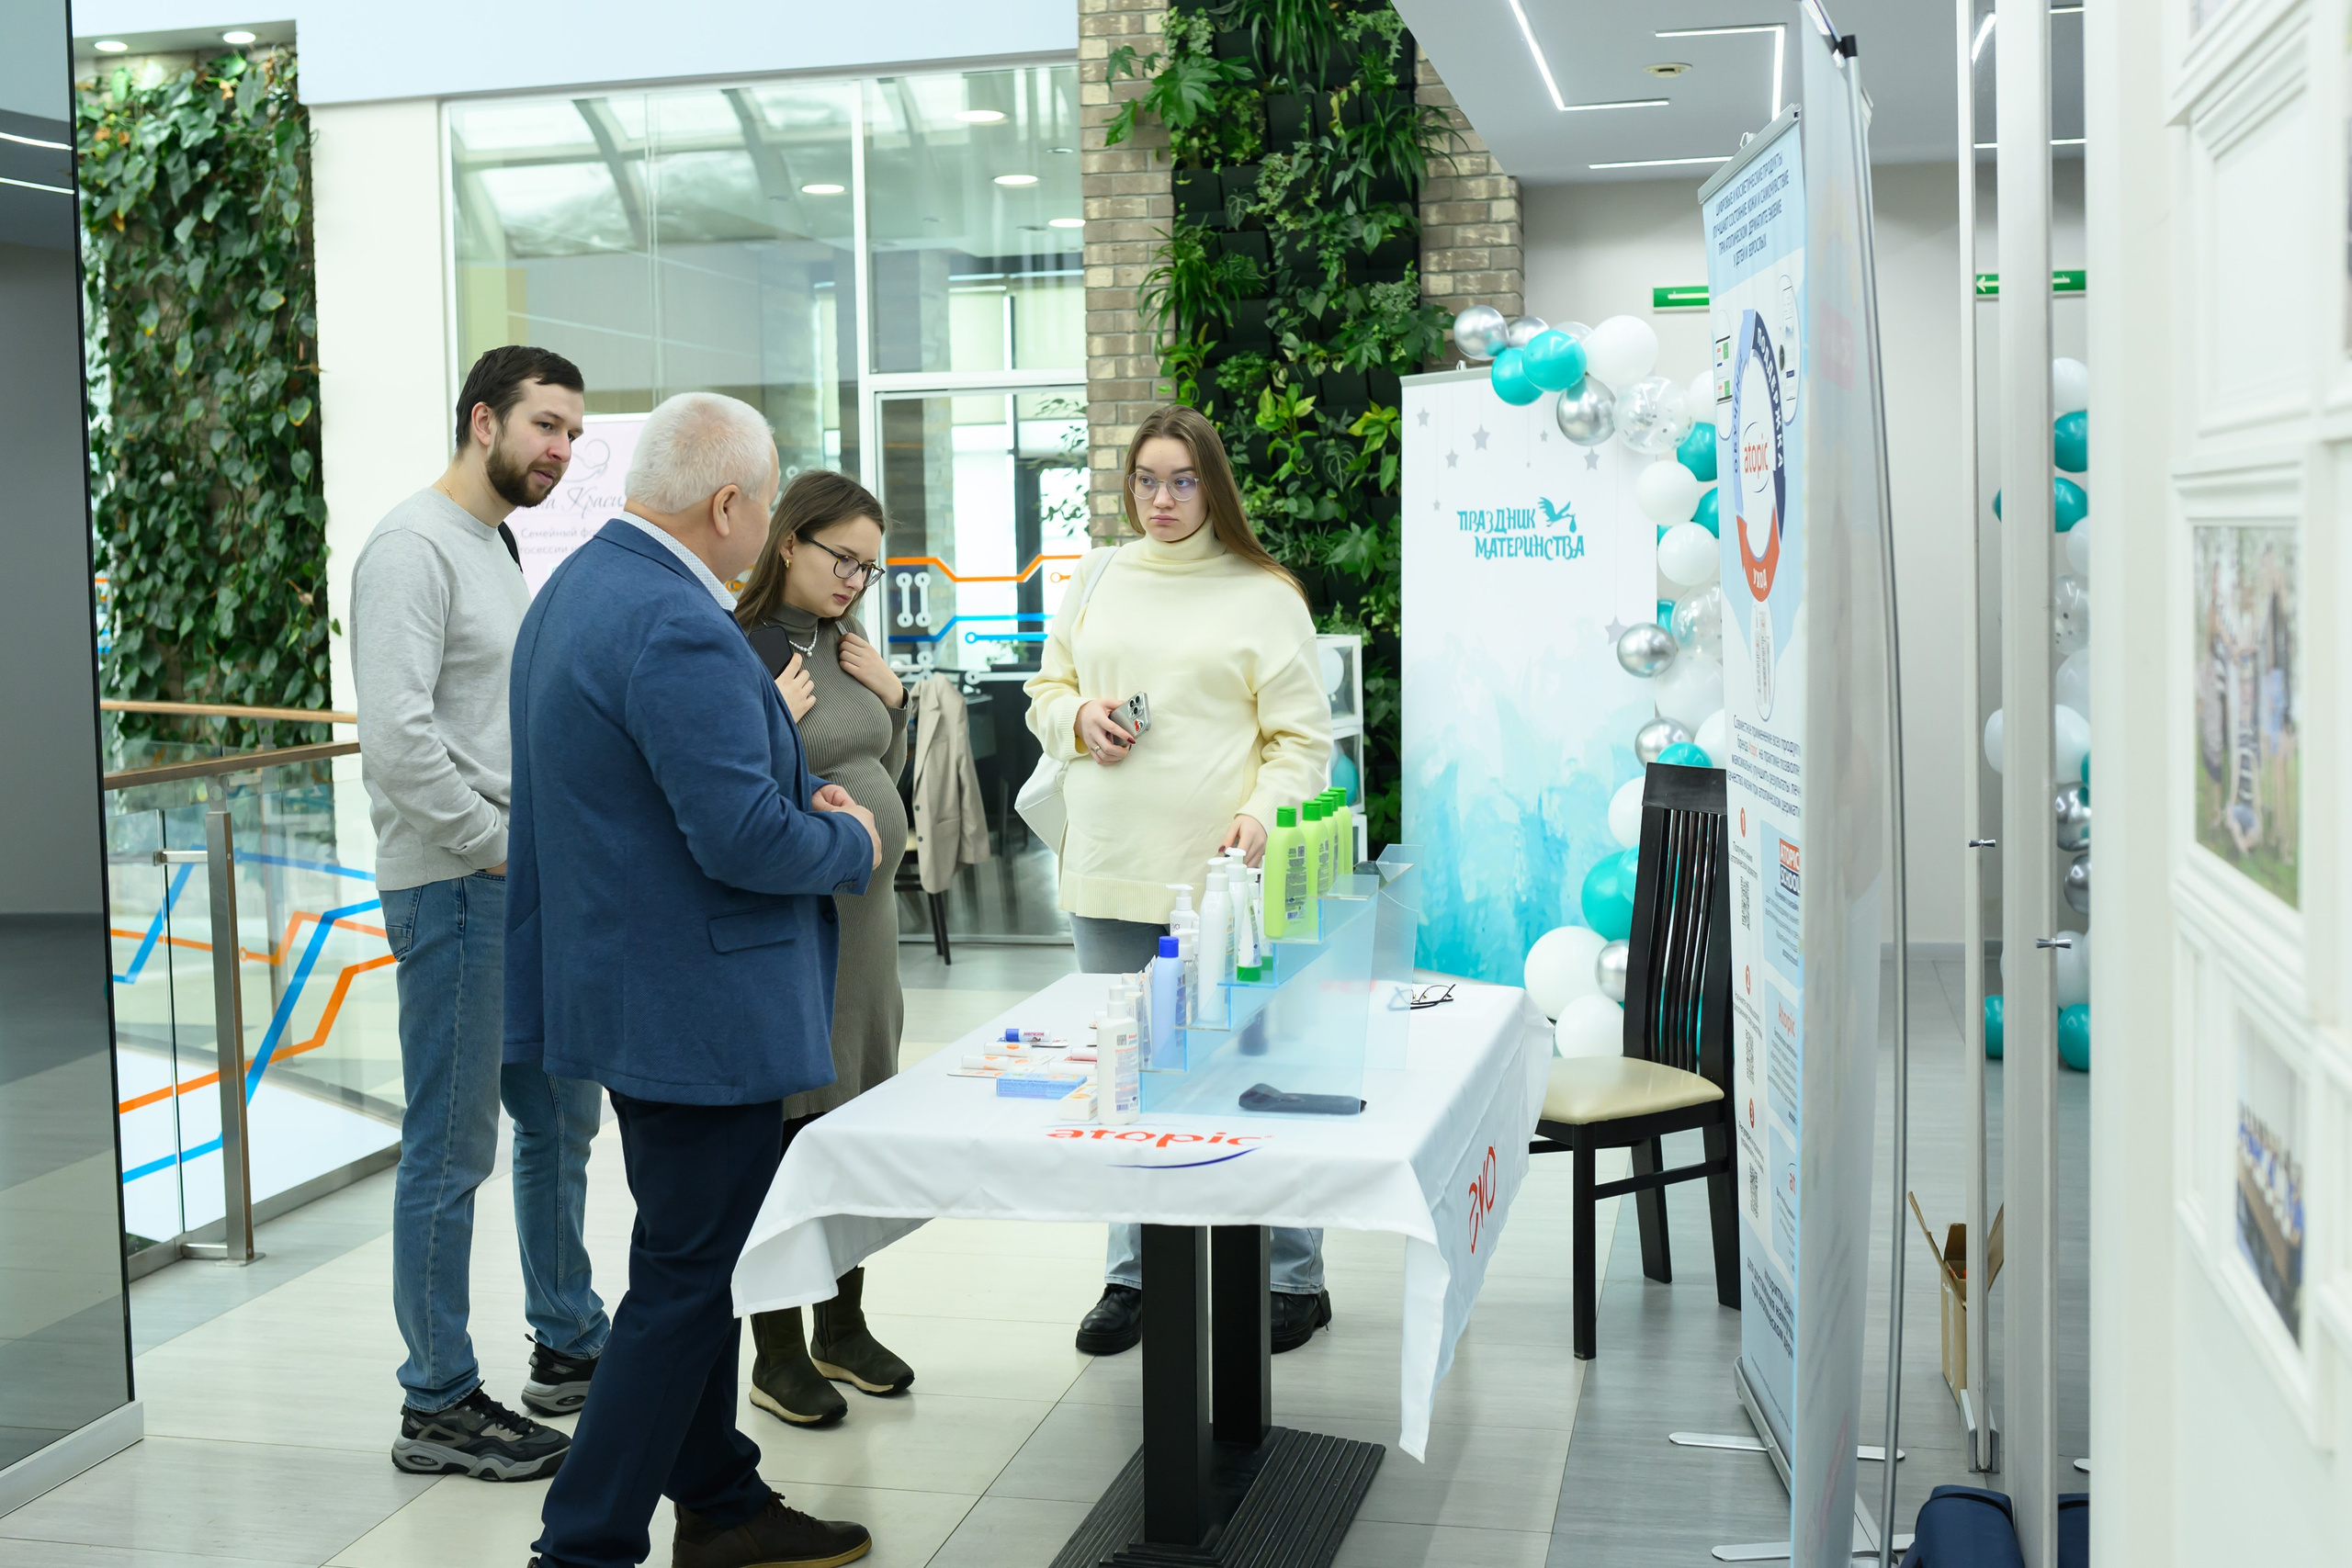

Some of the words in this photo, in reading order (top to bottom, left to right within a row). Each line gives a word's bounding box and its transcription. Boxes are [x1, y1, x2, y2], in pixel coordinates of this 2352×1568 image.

[1757, 327, 1784, 468] ПОДДЕРЖКА
[1744, 433, 1770, 479] atopic
[521, 526, 578, 538] Семейный
[1456, 507, 1536, 535] ПРАЗДНИК
[1475, 534, 1585, 561] МАТЕРИНСТВА
[1753, 567, 1768, 591] УХОД
[1781, 842, 1800, 871] ATOPIC
[1779, 1001, 1795, 1038] Atopic
[1046, 1129, 1262, 1148] atopic
